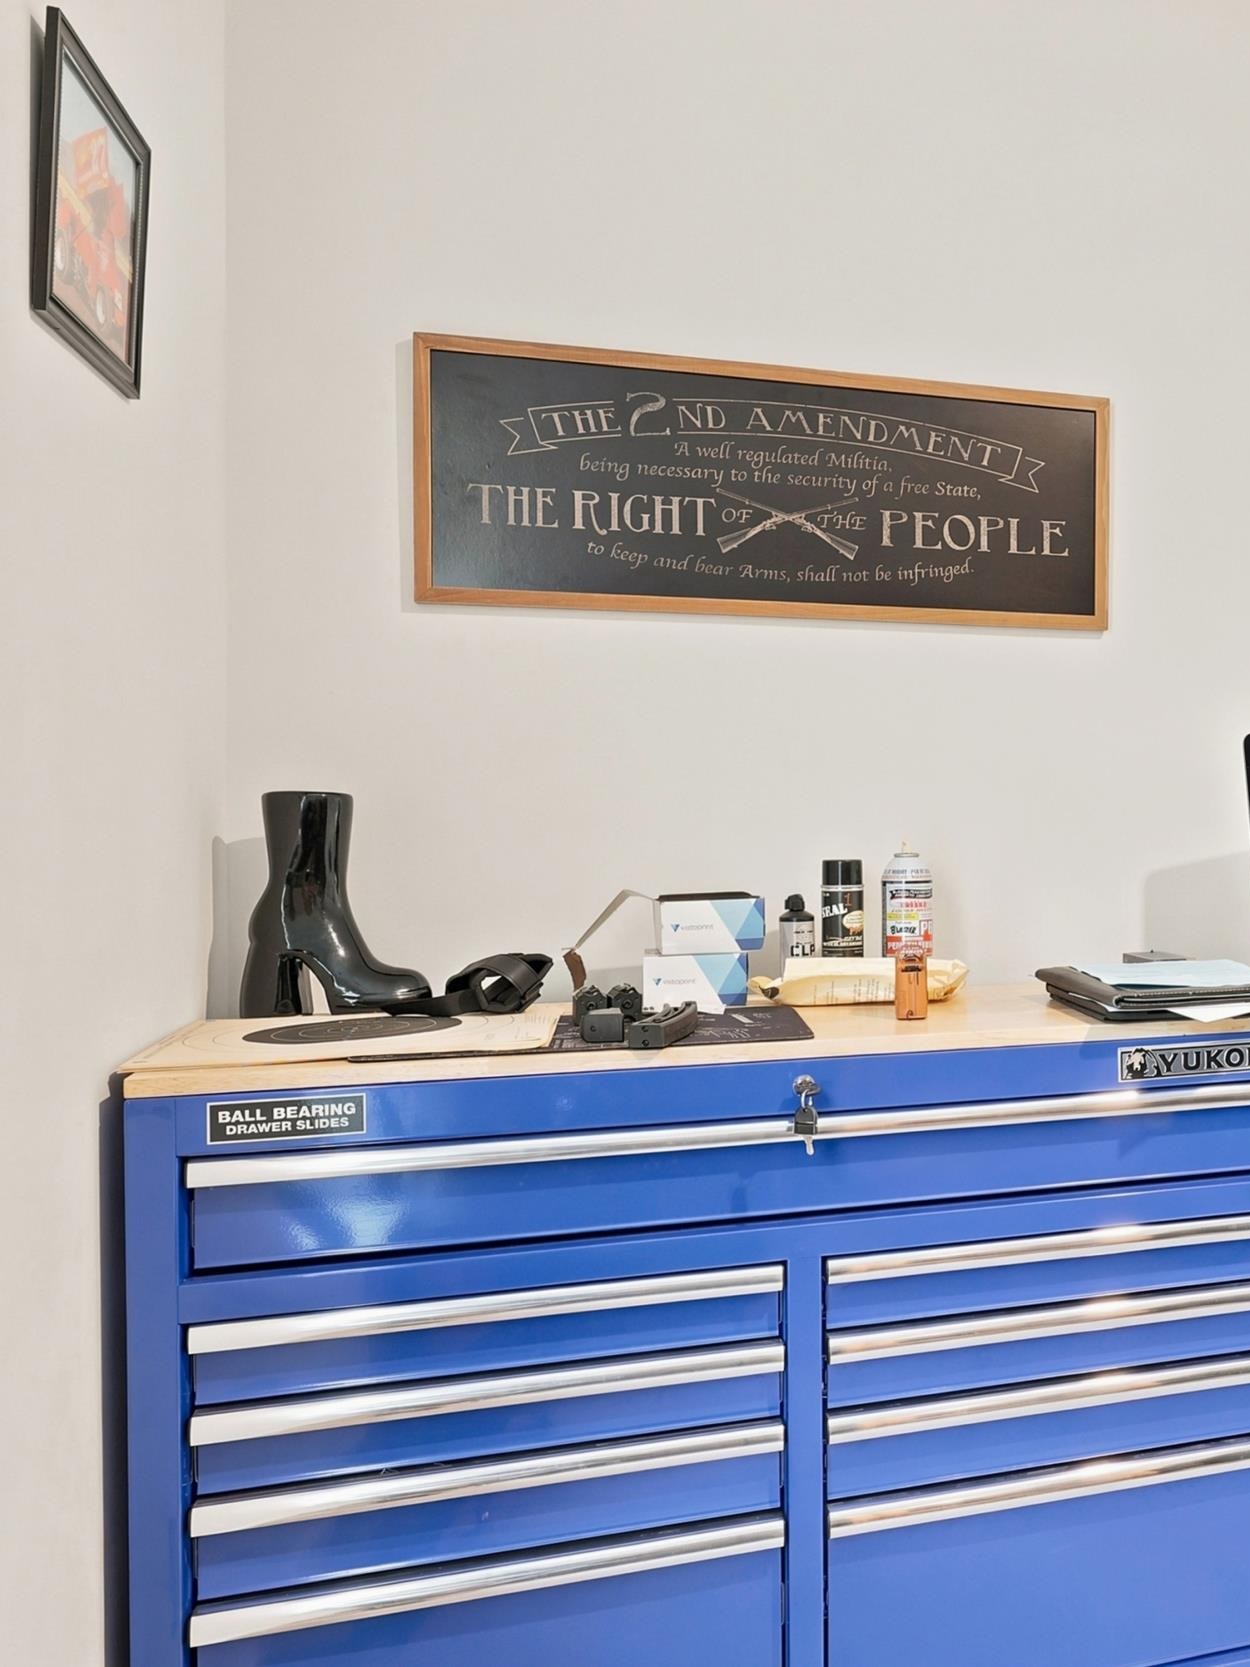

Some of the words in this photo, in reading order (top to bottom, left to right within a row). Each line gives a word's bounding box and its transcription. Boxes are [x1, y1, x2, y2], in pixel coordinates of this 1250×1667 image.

[541, 407, 622, 436] THE
[745, 408, 1001, 467] AMENDMENT
[674, 441, 690, 457] A
[695, 441, 735, 460] well
[737, 445, 824, 468] regulated
[579, 452, 630, 482] being
[637, 465, 724, 487] necessary
[730, 468, 748, 482] to
[753, 465, 781, 484] the
[787, 471, 857, 497] security
[862, 473, 882, 498] of
[883, 480, 894, 493] a
[894, 475, 929, 500] free
[935, 481, 982, 500] State,
[466, 483, 559, 528] THE
[571, 489, 717, 536] RIGHT
[721, 507, 753, 524] OF
[816, 511, 867, 531] THE
[879, 509, 1070, 557] PEOPLE
[587, 541, 605, 556] to
[610, 542, 649, 570] keep
[653, 555, 695, 571] and
[694, 555, 733, 576] bear
[738, 563, 791, 584] Arms,
[796, 564, 840, 583] shall
[842, 569, 870, 583] not
[874, 564, 892, 582] be
[898, 557, 975, 586] infringed.
[217, 1108, 267, 1124] BALL
[272, 1102, 356, 1120] BEARING
[225, 1121, 292, 1136] DRAWER
[296, 1116, 349, 1131] SLIDES
